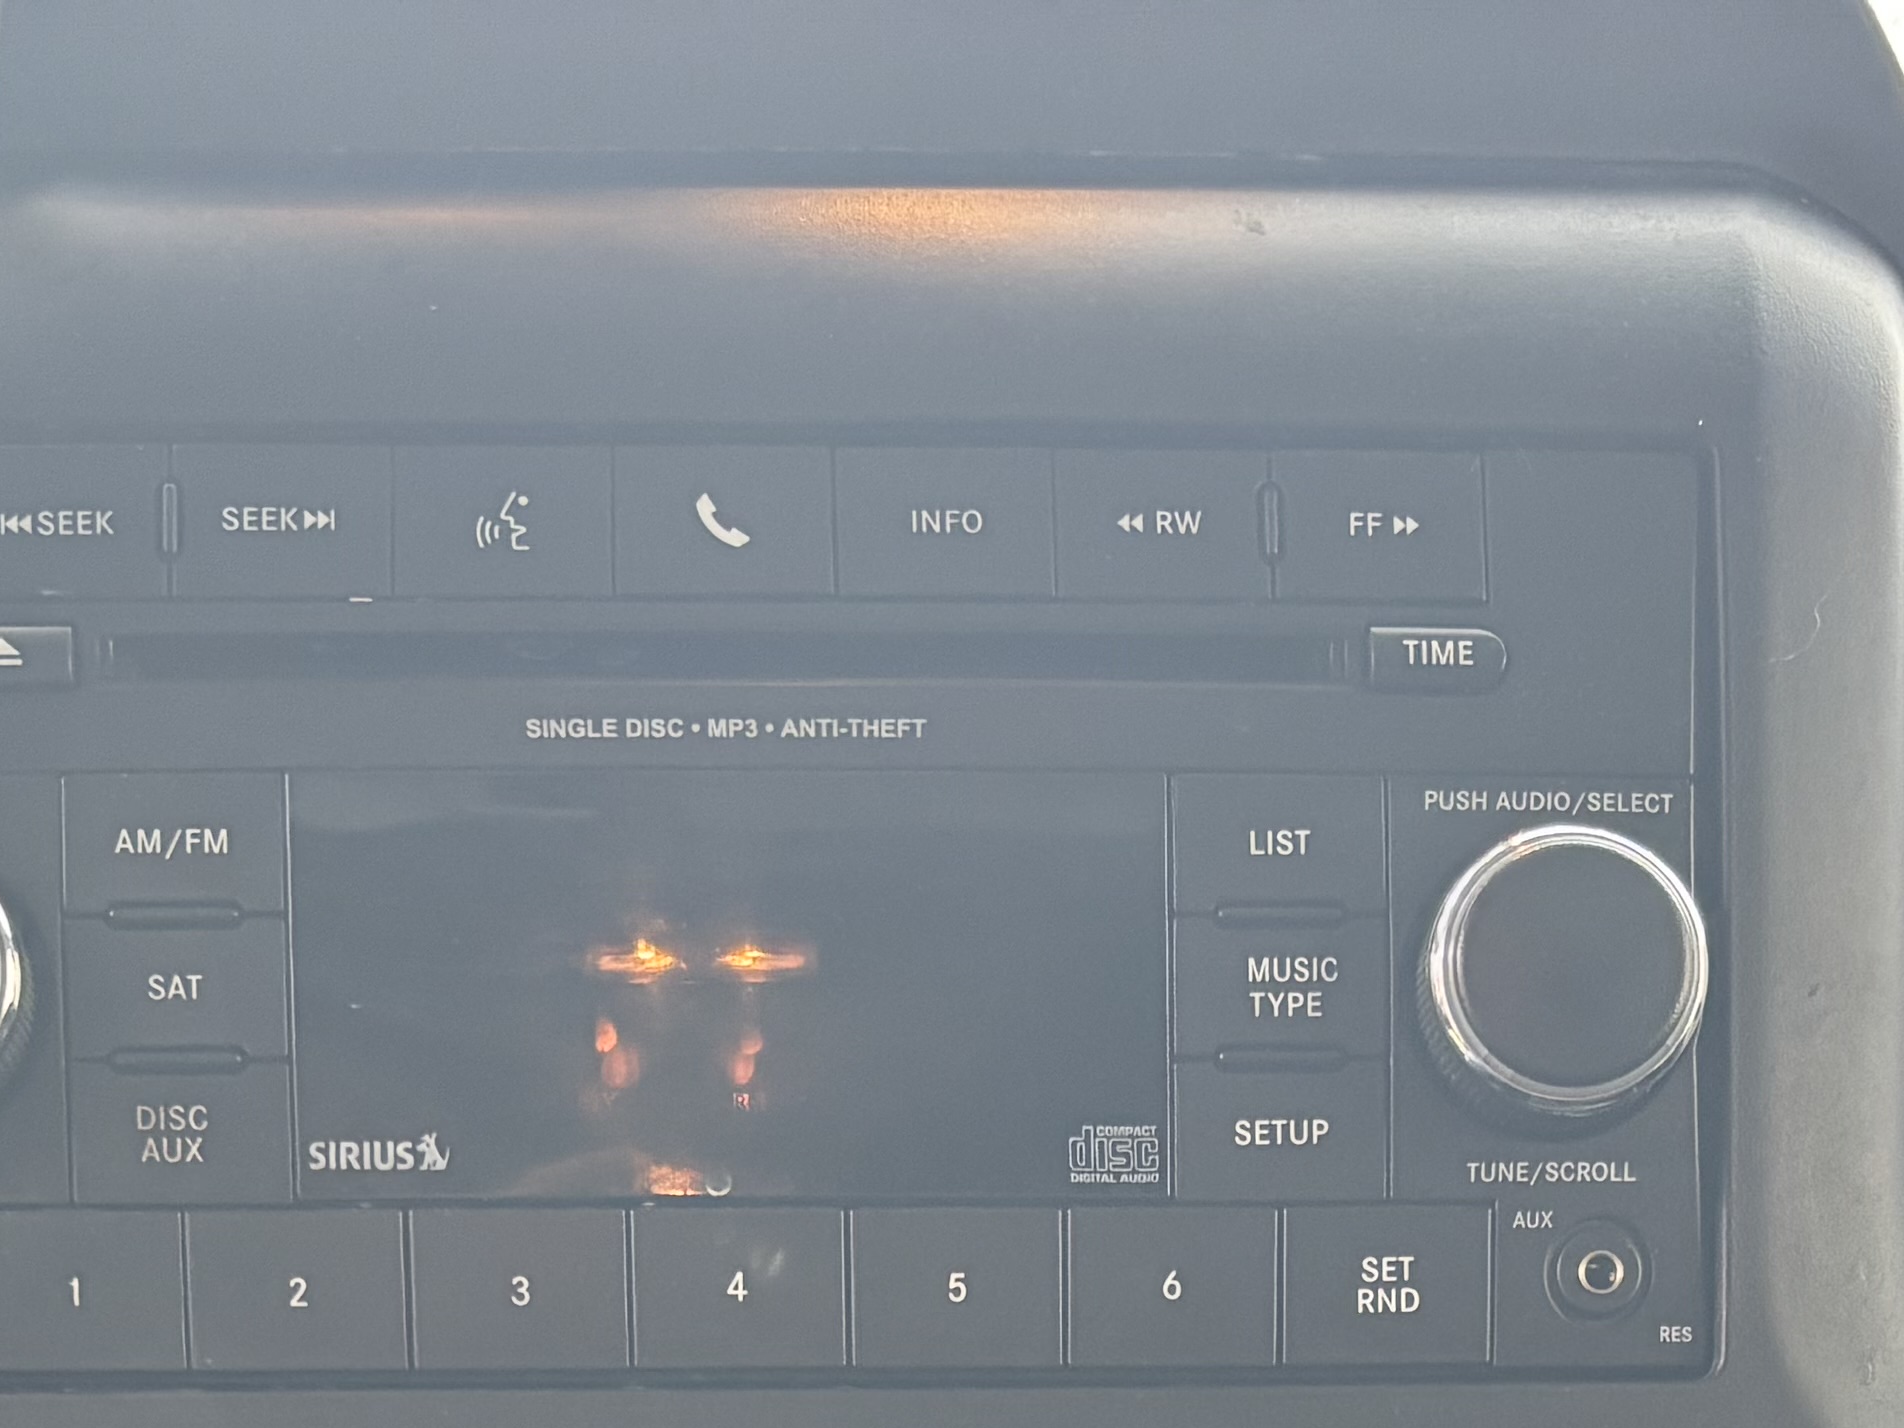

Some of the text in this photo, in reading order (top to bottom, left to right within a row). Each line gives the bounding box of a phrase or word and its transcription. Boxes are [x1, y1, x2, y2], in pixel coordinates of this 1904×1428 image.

[37, 510, 114, 536] SEEK
[221, 506, 298, 532] SEEK
[911, 509, 983, 535] INFO
[1156, 510, 1202, 535] RW
[1349, 512, 1384, 537] FF
[1403, 640, 1475, 666] TIME
[525, 718, 927, 739] SINGLE DISC MP3 ANTI-THEFT
[1424, 790, 1674, 816] PUSH AUDIO/SELECT
[114, 828, 229, 860] AM/FM
[1249, 829, 1311, 856] LIST
[1248, 956, 1338, 983] MUSIC
[148, 974, 203, 1001] SAT
[1249, 991, 1323, 1018] TYPE
[136, 1104, 209, 1132] DISC
[1096, 1125, 1157, 1137] COMPACT
[1234, 1118, 1329, 1147] SETUP
[141, 1137, 204, 1163] AUX
[308, 1140, 415, 1171] SIRIUS
[1070, 1172, 1160, 1184] DIGITAL AUDIO
[1466, 1161, 1637, 1186] TUNE/SCROLL
[1512, 1210, 1553, 1230] AUX
[1361, 1256, 1415, 1284] SET
[68, 1276, 81, 1307] 1
[289, 1277, 309, 1307] 2
[511, 1275, 531, 1307] 3
[726, 1271, 749, 1302] 4
[948, 1272, 967, 1303] 5
[1162, 1269, 1182, 1300] 6
[1357, 1287, 1420, 1314] RND
[1659, 1325, 1693, 1343] RES
